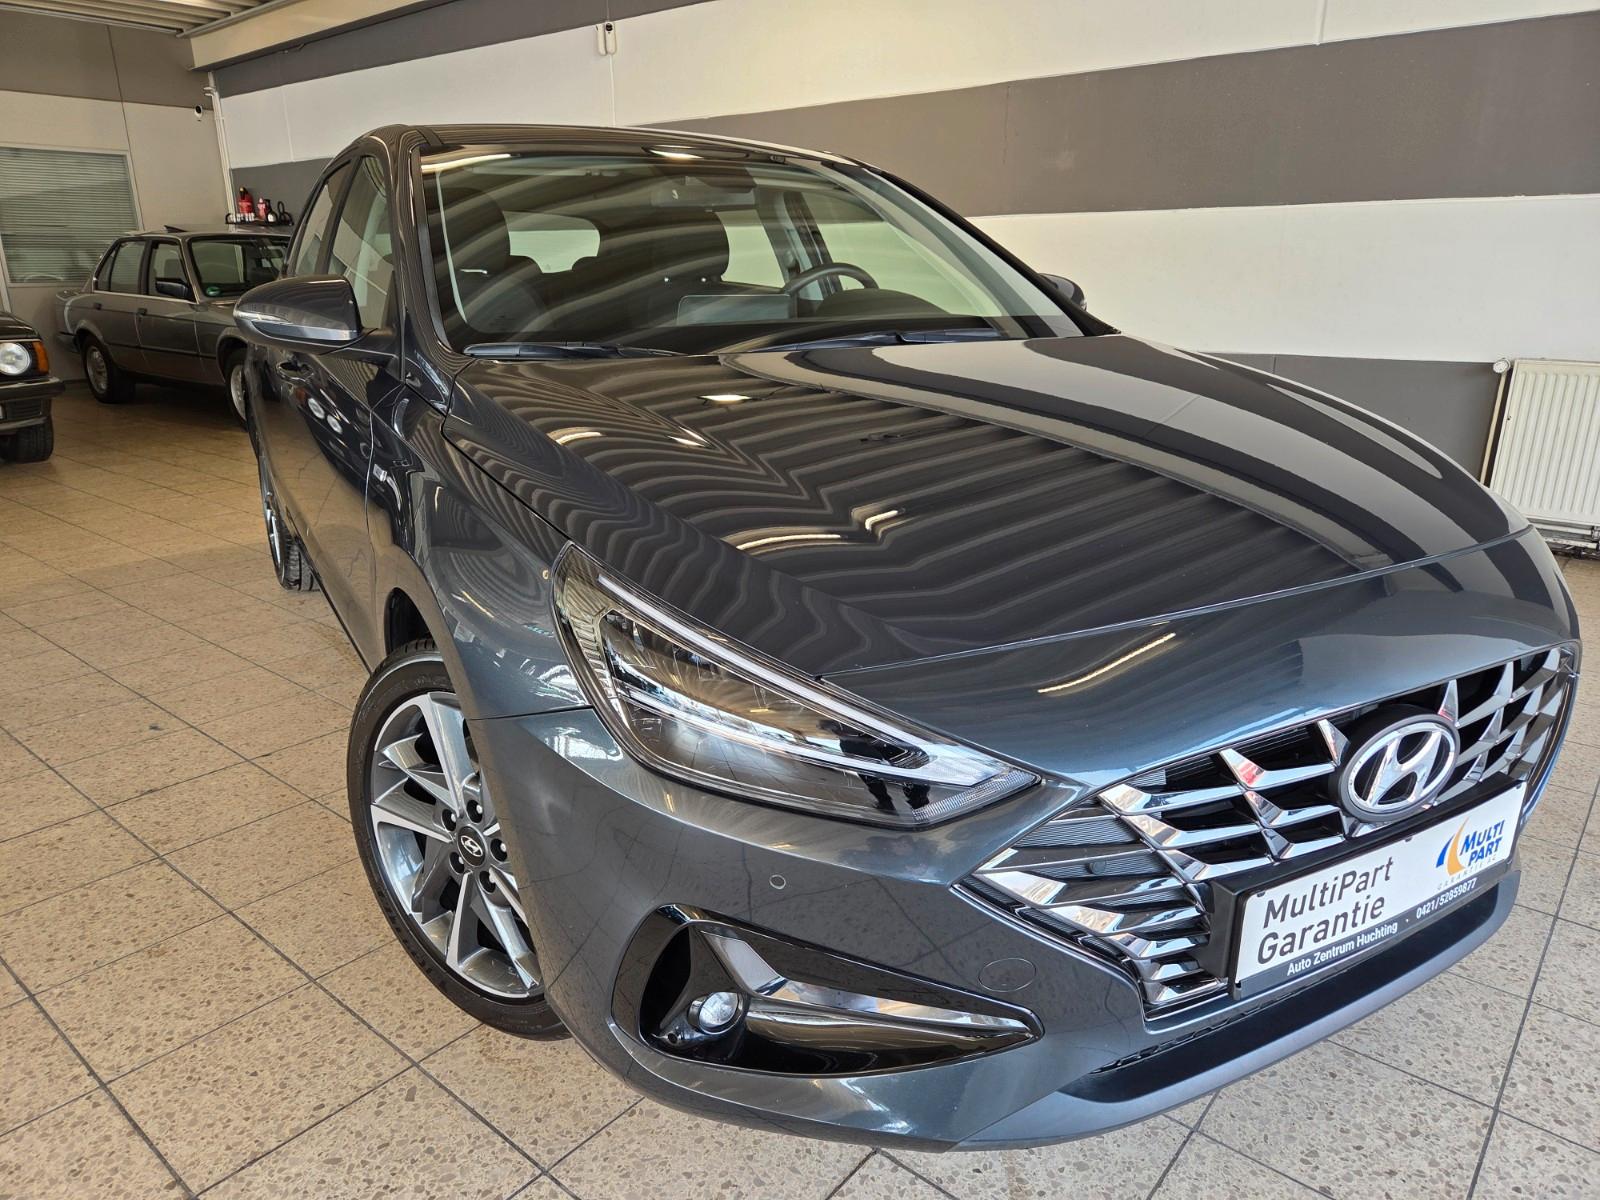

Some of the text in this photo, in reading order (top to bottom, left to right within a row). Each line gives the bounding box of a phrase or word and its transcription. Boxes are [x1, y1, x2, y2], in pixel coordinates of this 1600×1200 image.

[1460, 819, 1505, 856] MULTI
[1468, 837, 1502, 867] PART
[1263, 856, 1394, 929] MultiPart
[1257, 894, 1385, 965] Garantie
[1287, 959, 1312, 977] Auto
[1313, 941, 1355, 966] Zentrum
[1356, 922, 1398, 948] Huchting
